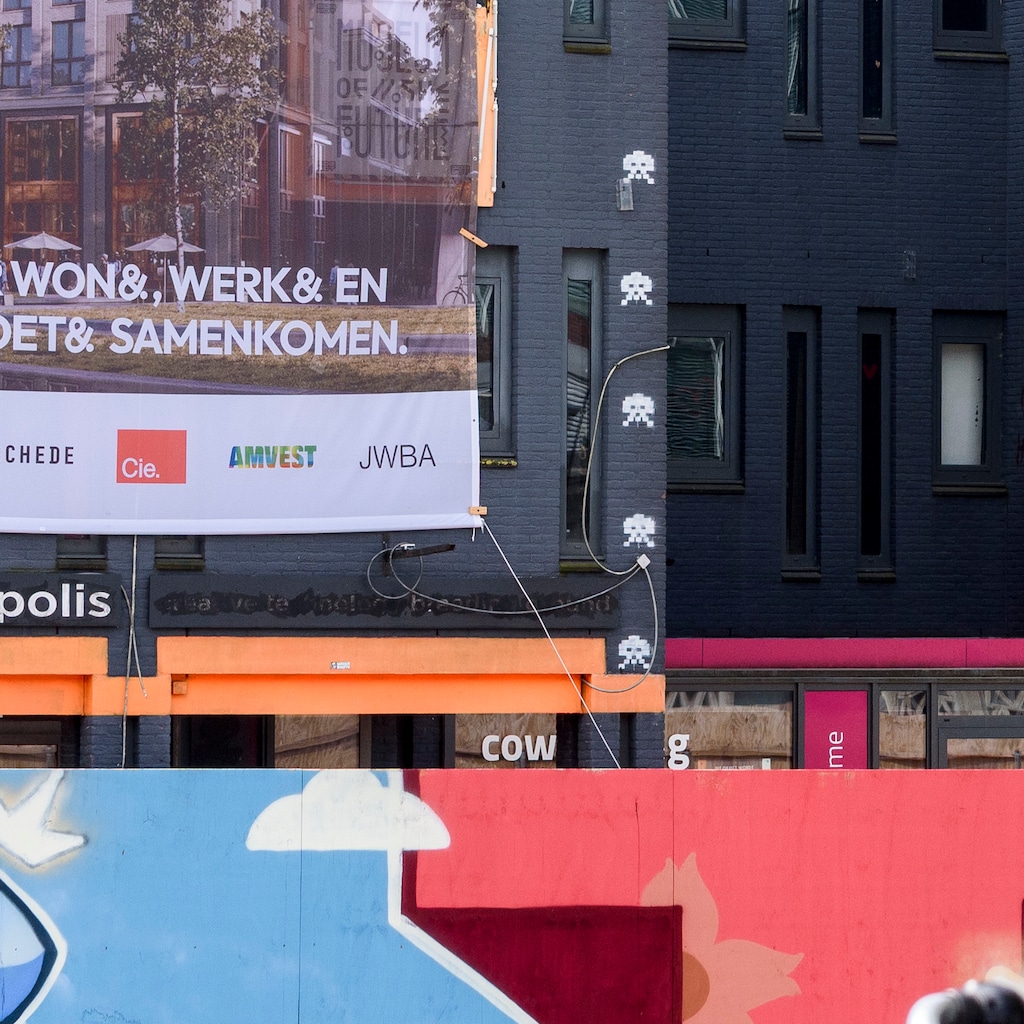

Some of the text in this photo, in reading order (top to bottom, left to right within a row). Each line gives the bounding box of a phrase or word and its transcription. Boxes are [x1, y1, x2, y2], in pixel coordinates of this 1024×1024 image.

[336, 268, 388, 303] EN
[109, 317, 408, 356] SAMENKOMEN.
[5, 445, 74, 465] CHEDE
[121, 457, 161, 479] Cie.
[228, 445, 317, 469] AMVEST
[359, 443, 437, 470] JWBA
[0, 583, 112, 624] polis
[481, 734, 557, 762] cow
[828, 731, 844, 768] me
